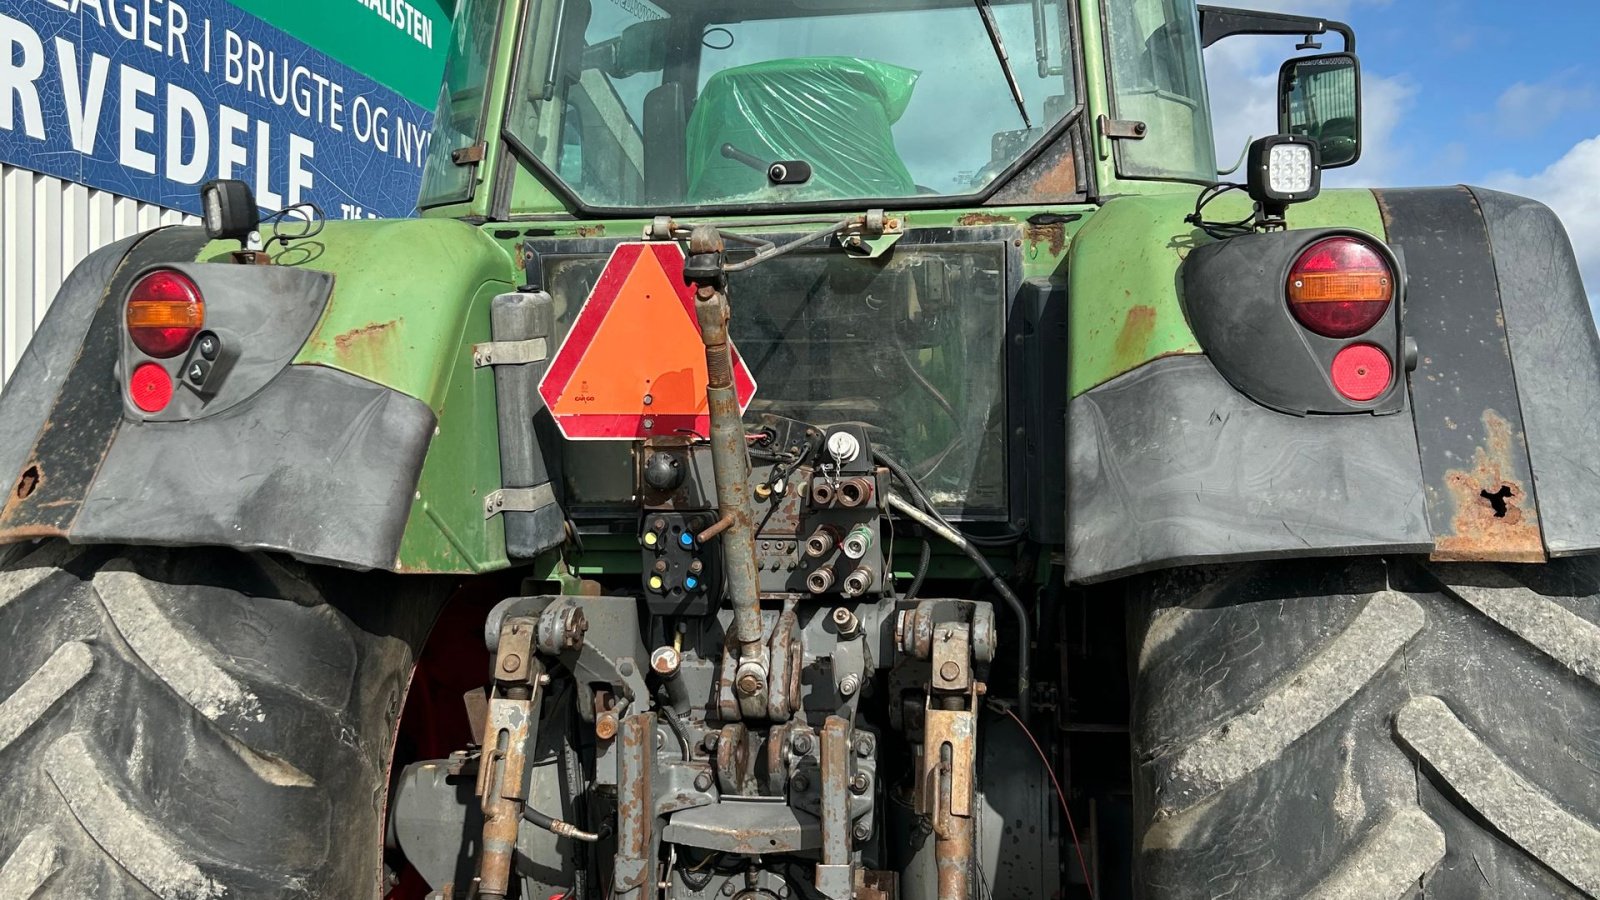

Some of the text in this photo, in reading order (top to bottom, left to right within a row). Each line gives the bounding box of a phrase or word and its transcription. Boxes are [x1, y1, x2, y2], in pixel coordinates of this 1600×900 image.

[204, 19, 210, 73] I
[225, 29, 343, 132] BRUGTE
[353, 96, 388, 152] OG
